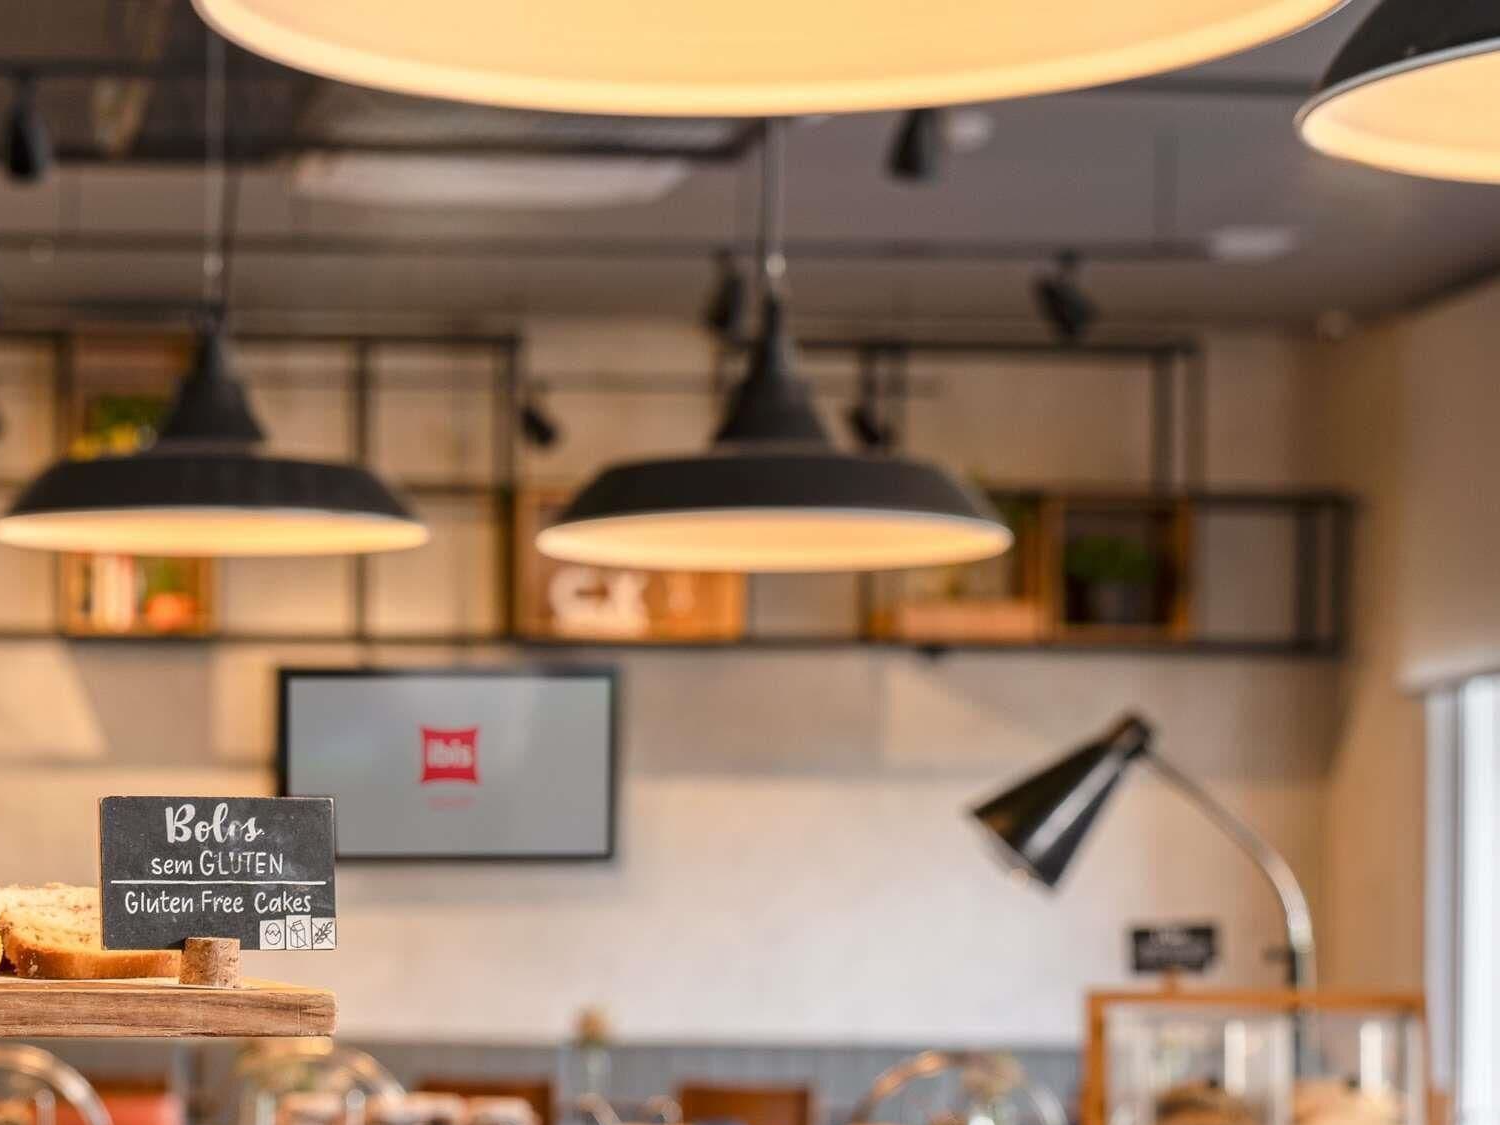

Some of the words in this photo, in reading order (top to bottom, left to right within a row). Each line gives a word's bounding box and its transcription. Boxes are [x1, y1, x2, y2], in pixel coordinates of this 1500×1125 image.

[151, 857, 193, 876] sem
[124, 890, 194, 915] Gluten
[201, 890, 244, 914] Free
[254, 890, 312, 915] Cakes
